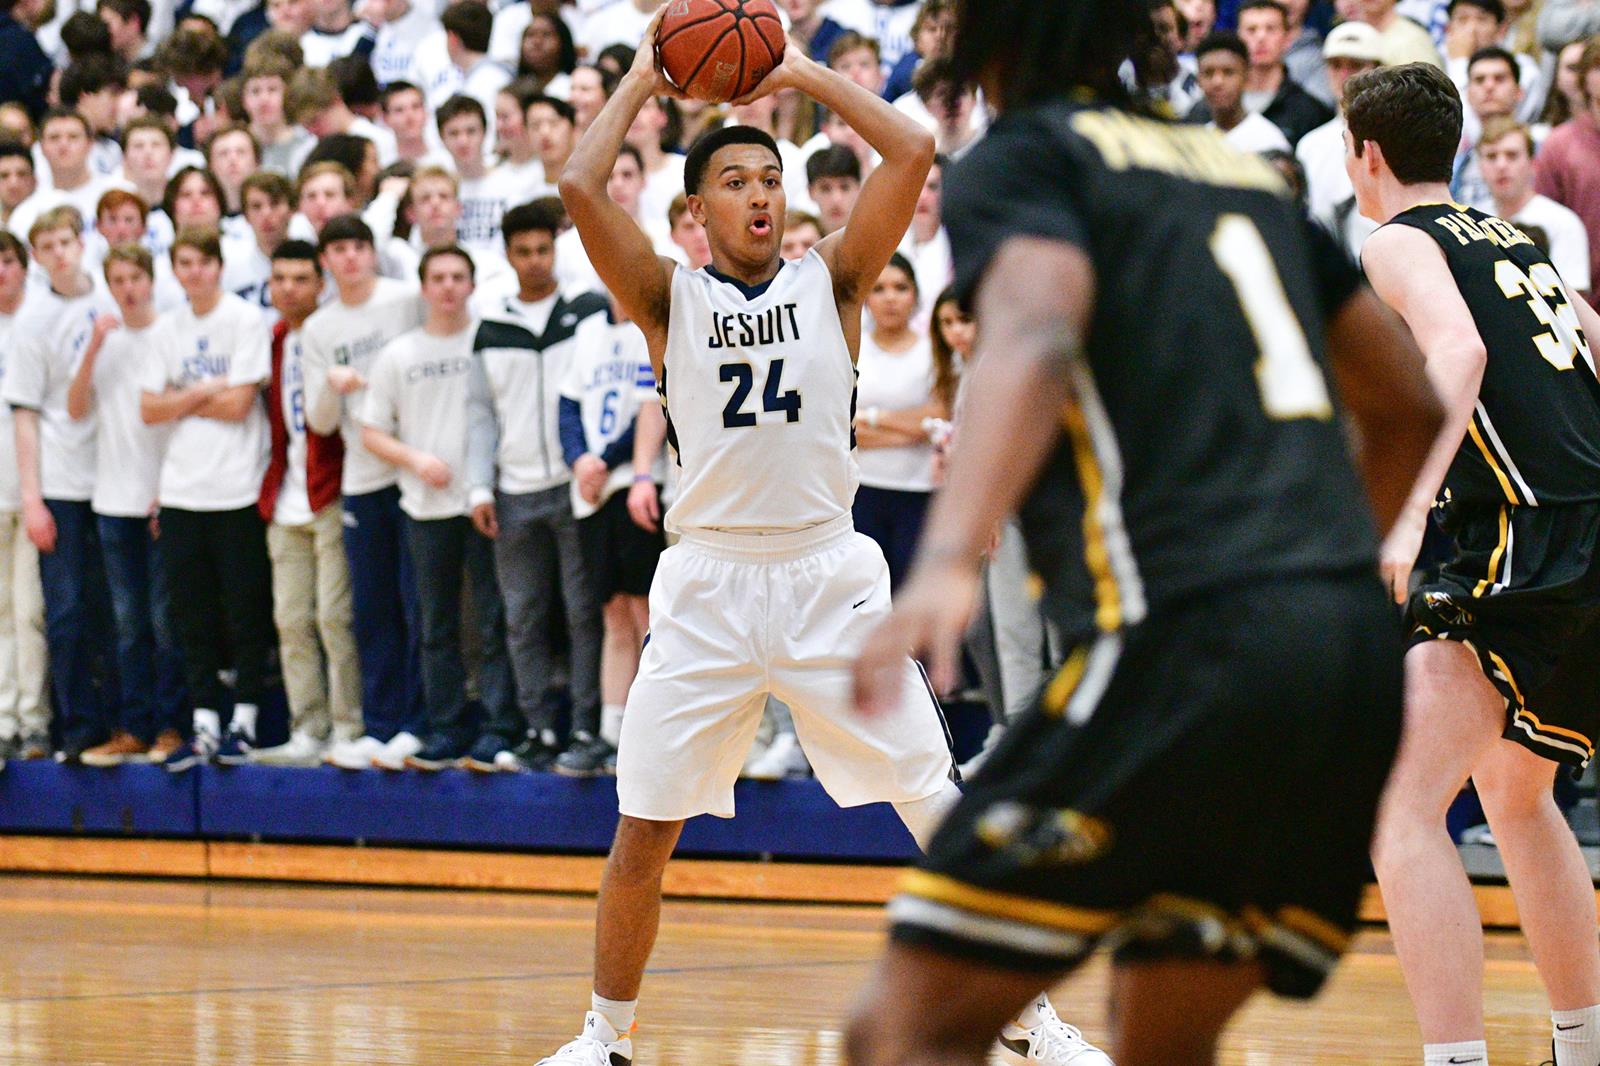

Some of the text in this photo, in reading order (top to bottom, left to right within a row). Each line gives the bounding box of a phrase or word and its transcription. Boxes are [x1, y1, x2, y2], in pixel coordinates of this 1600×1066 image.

[708, 303, 800, 348] JESUIT
[1209, 212, 1334, 421] 1
[600, 390, 618, 435] 6
[718, 358, 802, 429] 24
